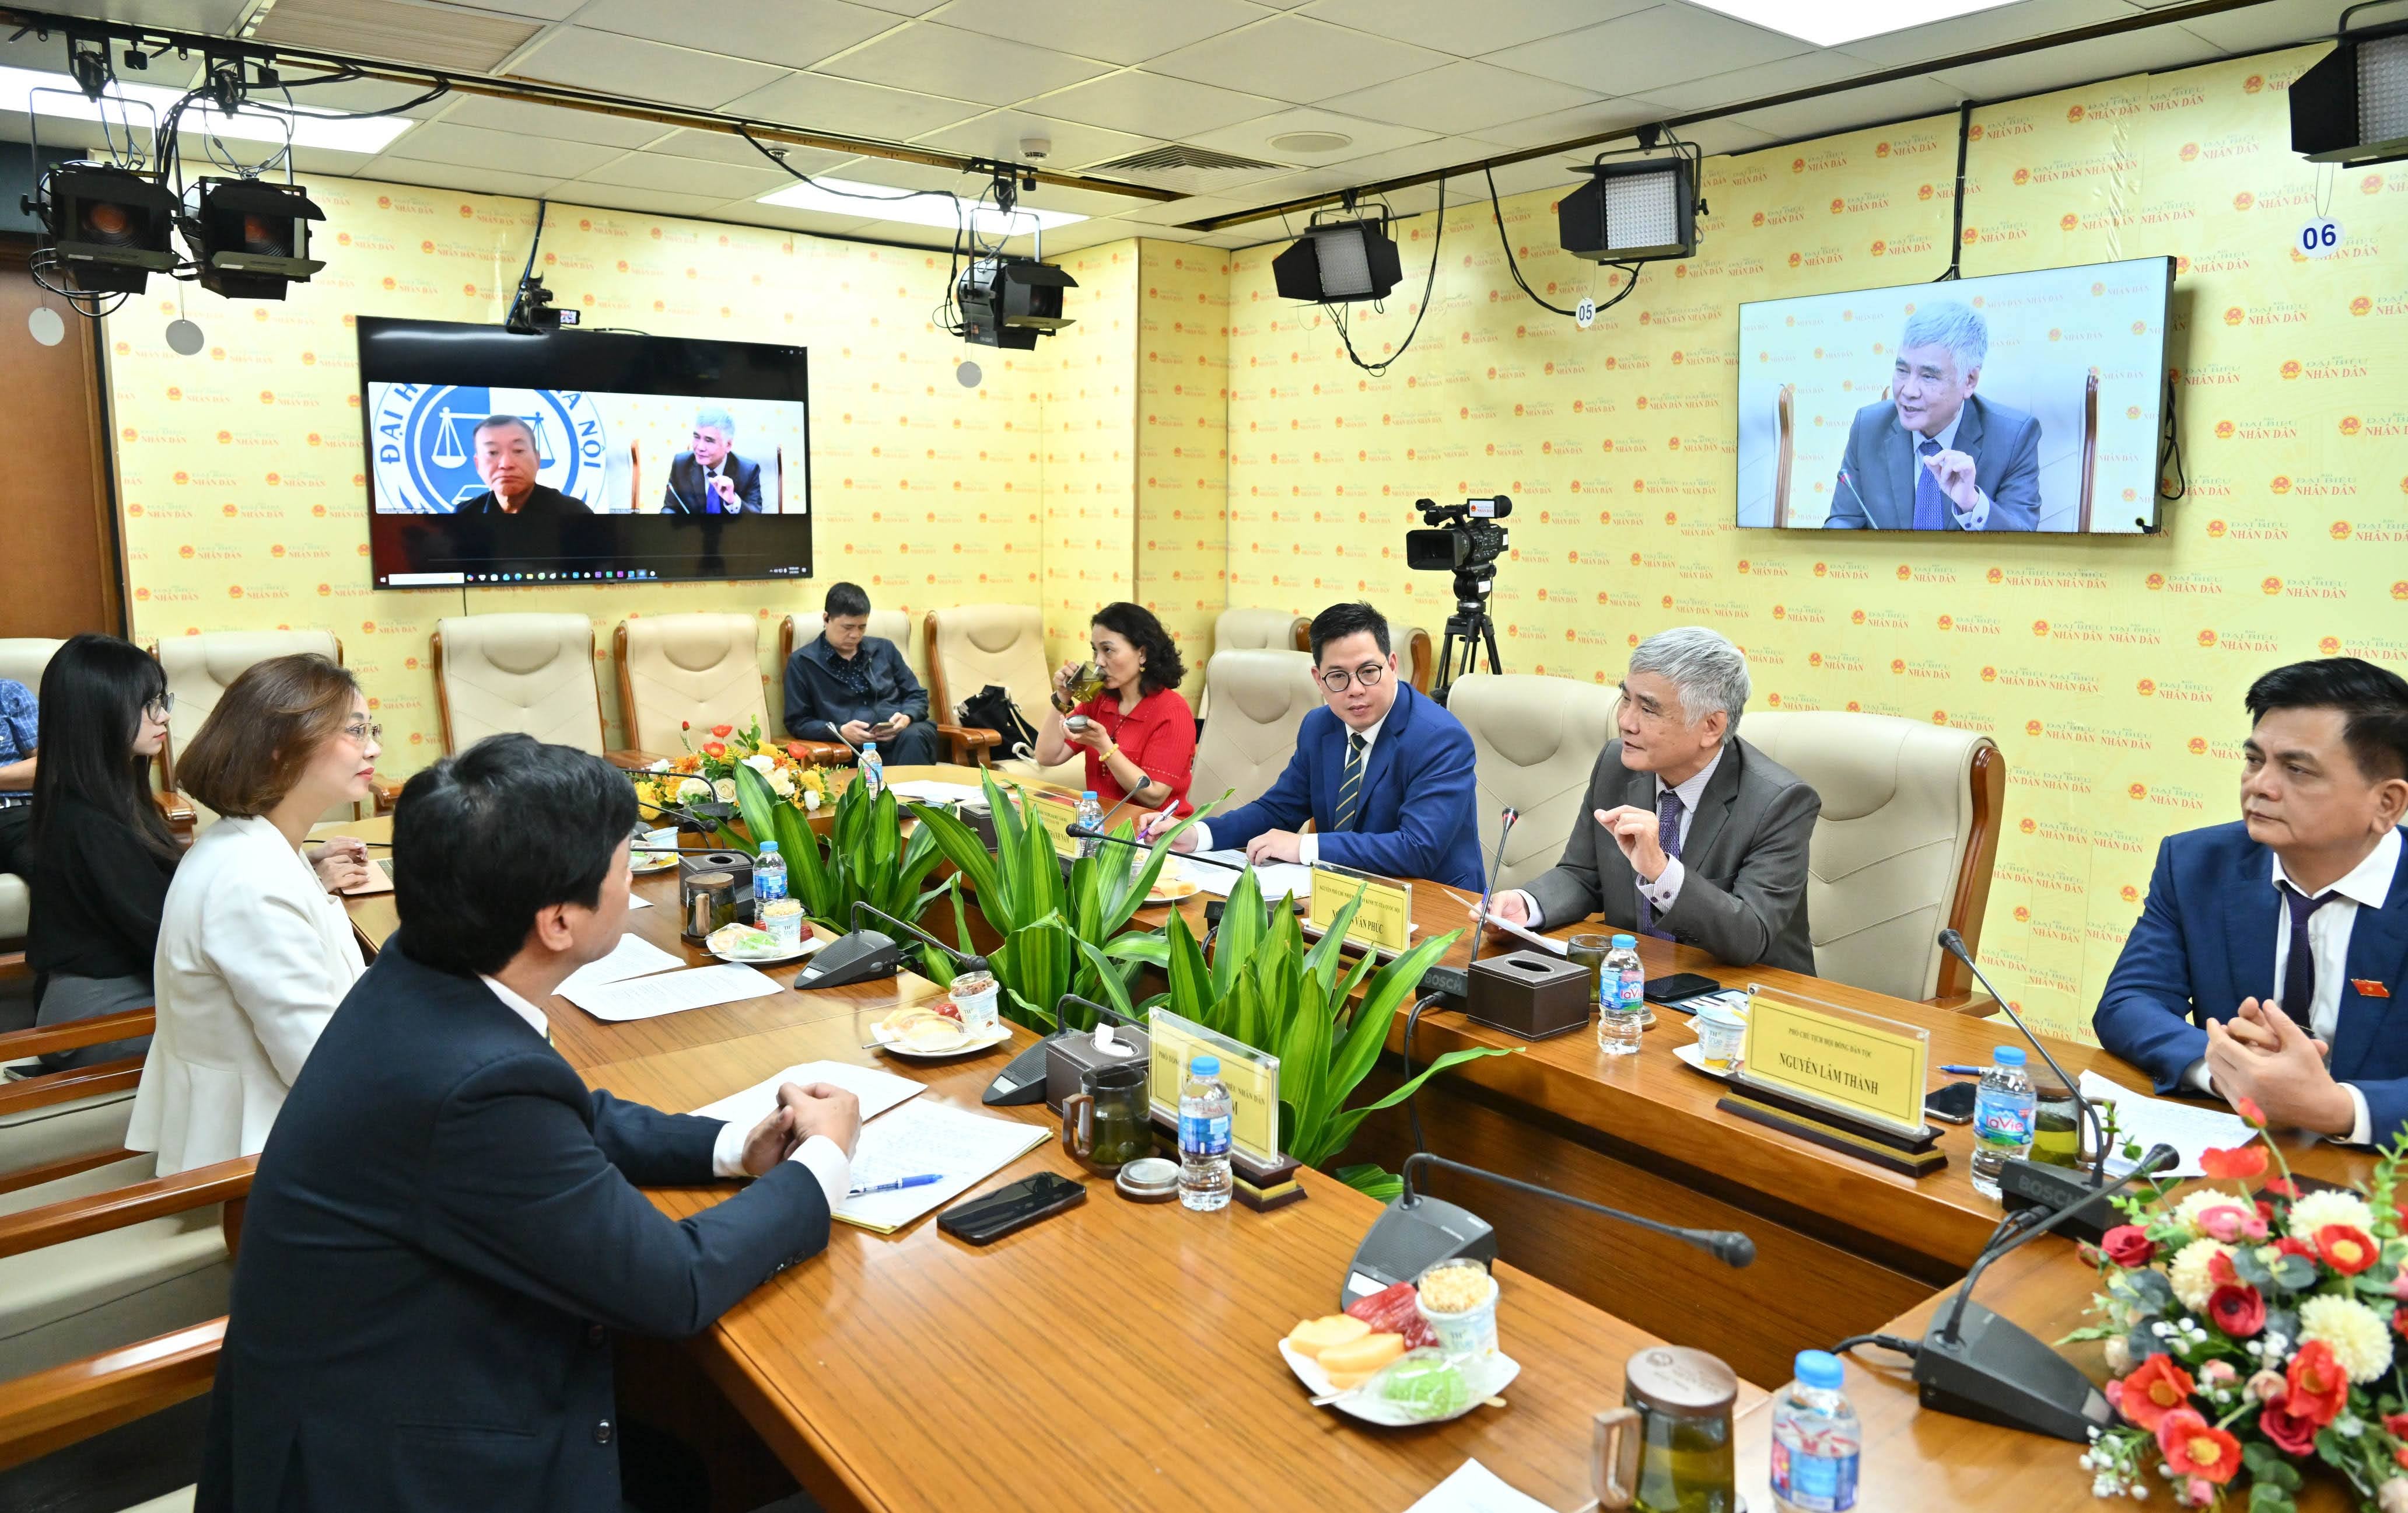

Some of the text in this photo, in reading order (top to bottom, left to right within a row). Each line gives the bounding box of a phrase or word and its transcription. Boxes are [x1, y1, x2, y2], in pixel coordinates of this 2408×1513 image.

[2303, 223, 2337, 250] 06
[1578, 304, 1592, 320] 05
[380, 410, 403, 464] ĐẠI
[578, 420, 606, 468] NỘI
[1355, 916, 1367, 928] VĂN
[1368, 920, 1384, 934] PHÚC
[1425, 973, 1462, 991] BOSCH
[1779, 1052, 1818, 1075] NGUYỄN
[1820, 1064, 1842, 1083] LÂM
